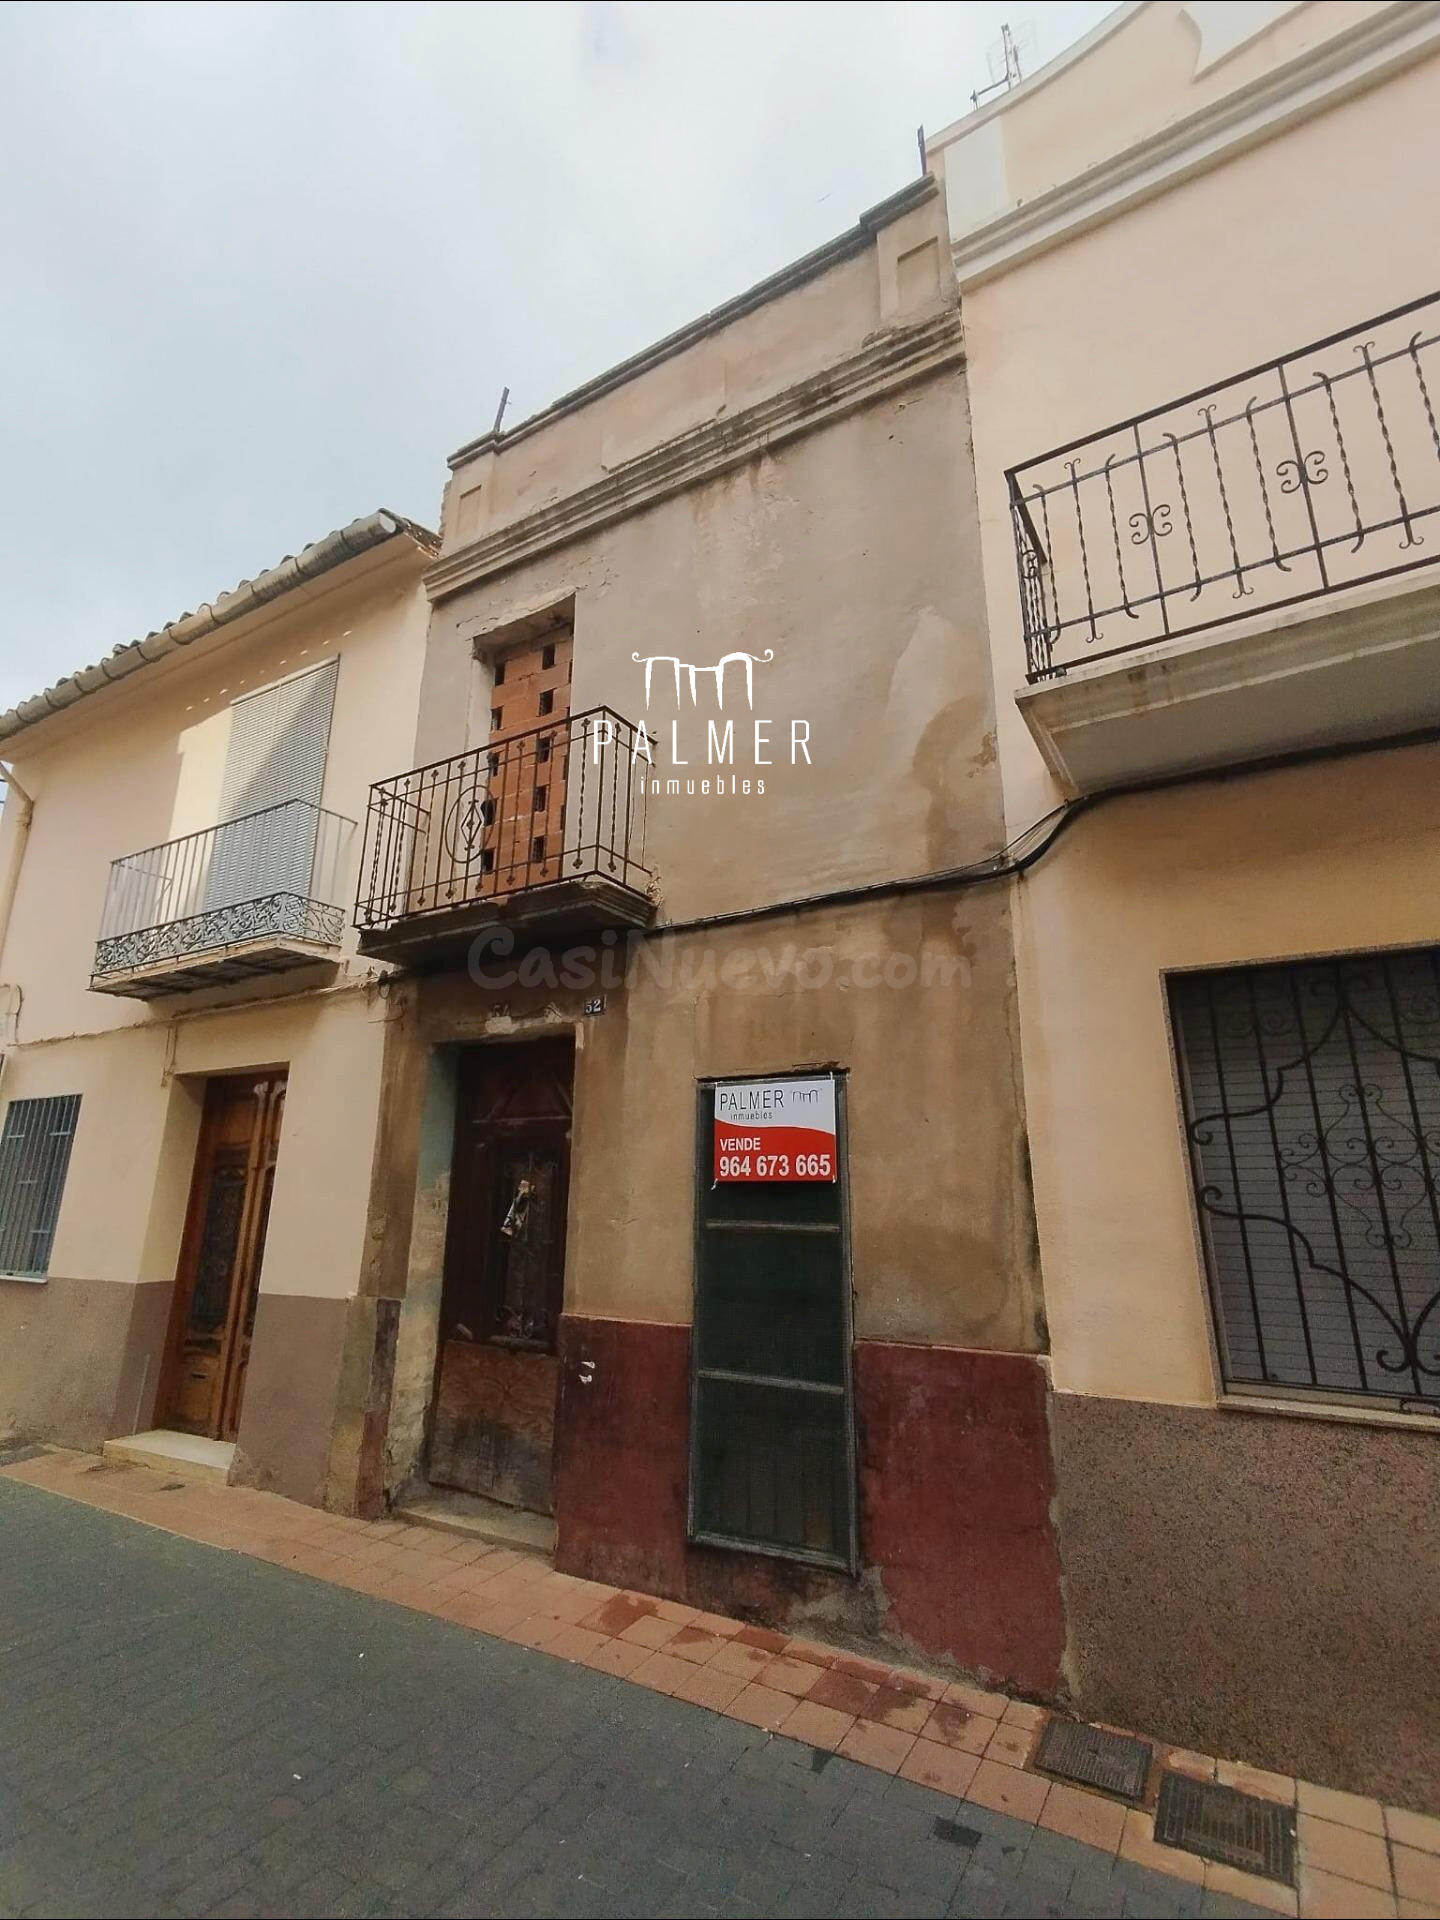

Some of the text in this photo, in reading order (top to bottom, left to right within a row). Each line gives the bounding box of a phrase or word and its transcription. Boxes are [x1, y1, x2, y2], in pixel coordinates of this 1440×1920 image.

[585, 999, 601, 1014] 52
[720, 1089, 784, 1111] PALMER
[730, 1111, 773, 1120] inmuebles
[719, 1137, 761, 1151] VENDE
[719, 1154, 831, 1177] 964 673 665
